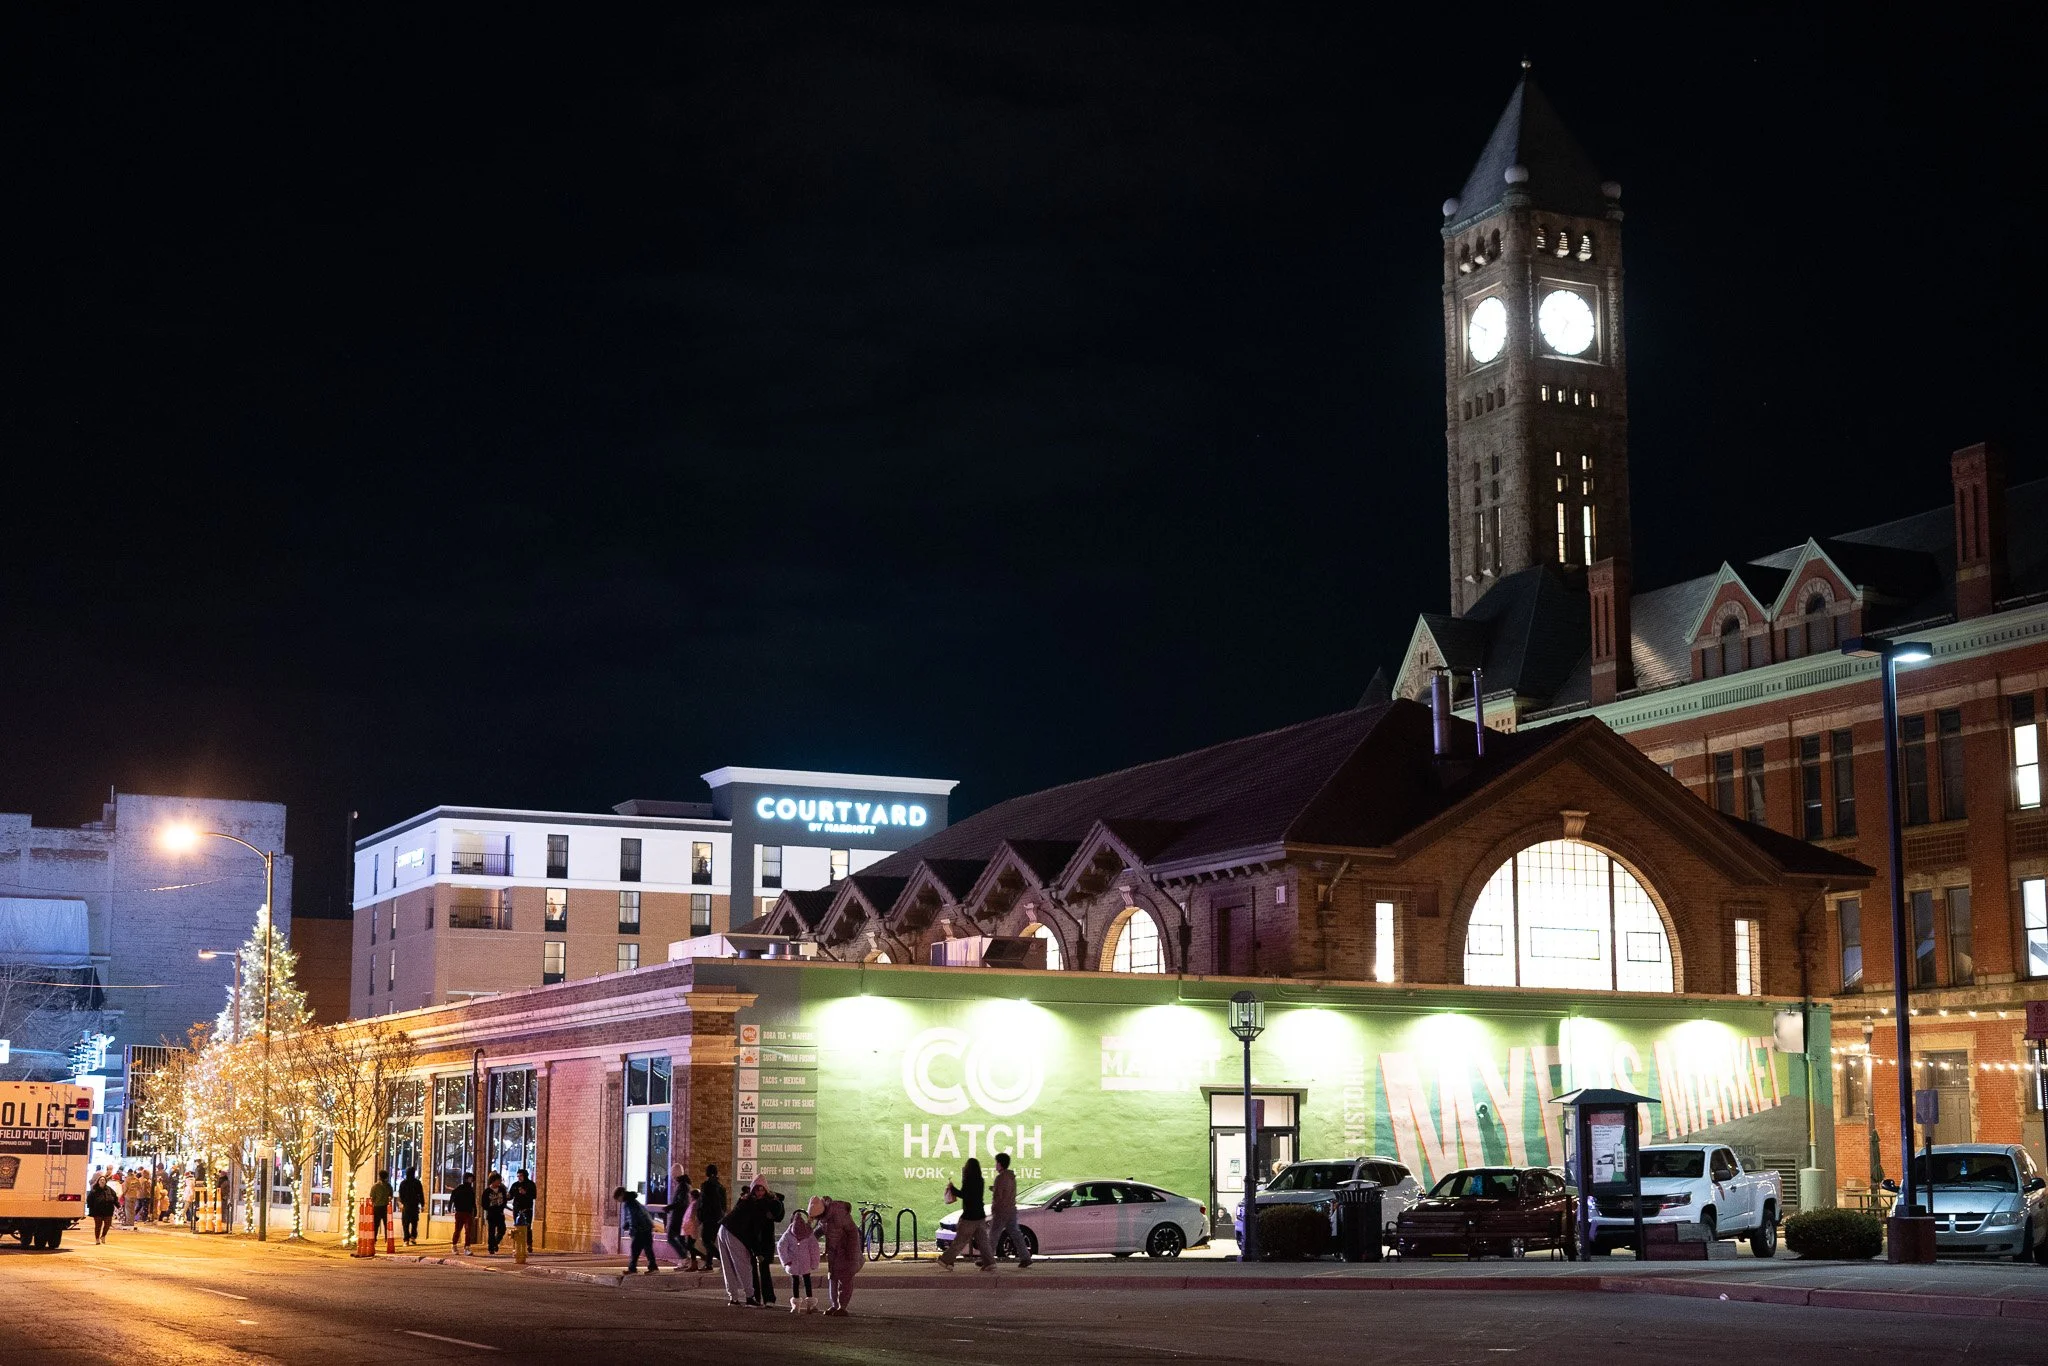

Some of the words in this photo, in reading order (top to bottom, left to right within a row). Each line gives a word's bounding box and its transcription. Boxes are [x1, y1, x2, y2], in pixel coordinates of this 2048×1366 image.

[756, 797, 928, 827] COURTYARD
[808, 823, 823, 832] BY
[762, 1031, 777, 1040] BOBA
[777, 1031, 787, 1040] TEA
[762, 1053, 777, 1062] SUSHI
[902, 1026, 1045, 1117] CO
[762, 1076, 778, 1085] TACOS
[783, 1076, 806, 1085] MEXICAN
[761, 1098, 779, 1107] PIZZAS
[783, 1099, 791, 1107] BY
[792, 1099, 801, 1107] THE
[801, 1099, 815, 1108] SLICE
[1, 1101, 77, 1128] OLICE
[1378, 1040, 1652, 1190] MYES
[1653, 1035, 1782, 1141] MARKET
[761, 1121, 776, 1130] FRESH
[776, 1121, 801, 1130] CONCEPTS
[23, 1130, 49, 1140] POLICE
[52, 1131, 86, 1141] DIVISION
[903, 1123, 1042, 1160] HATCH
[760, 1144, 784, 1153] COCKTAIL
[784, 1144, 803, 1153] LOUNGE
[760, 1166, 778, 1175] COFFEE
[782, 1166, 795, 1175] BEER
[800, 1166, 814, 1175] SODA
[903, 1167, 945, 1179] WORK
[1014, 1167, 1042, 1179] LIVE
